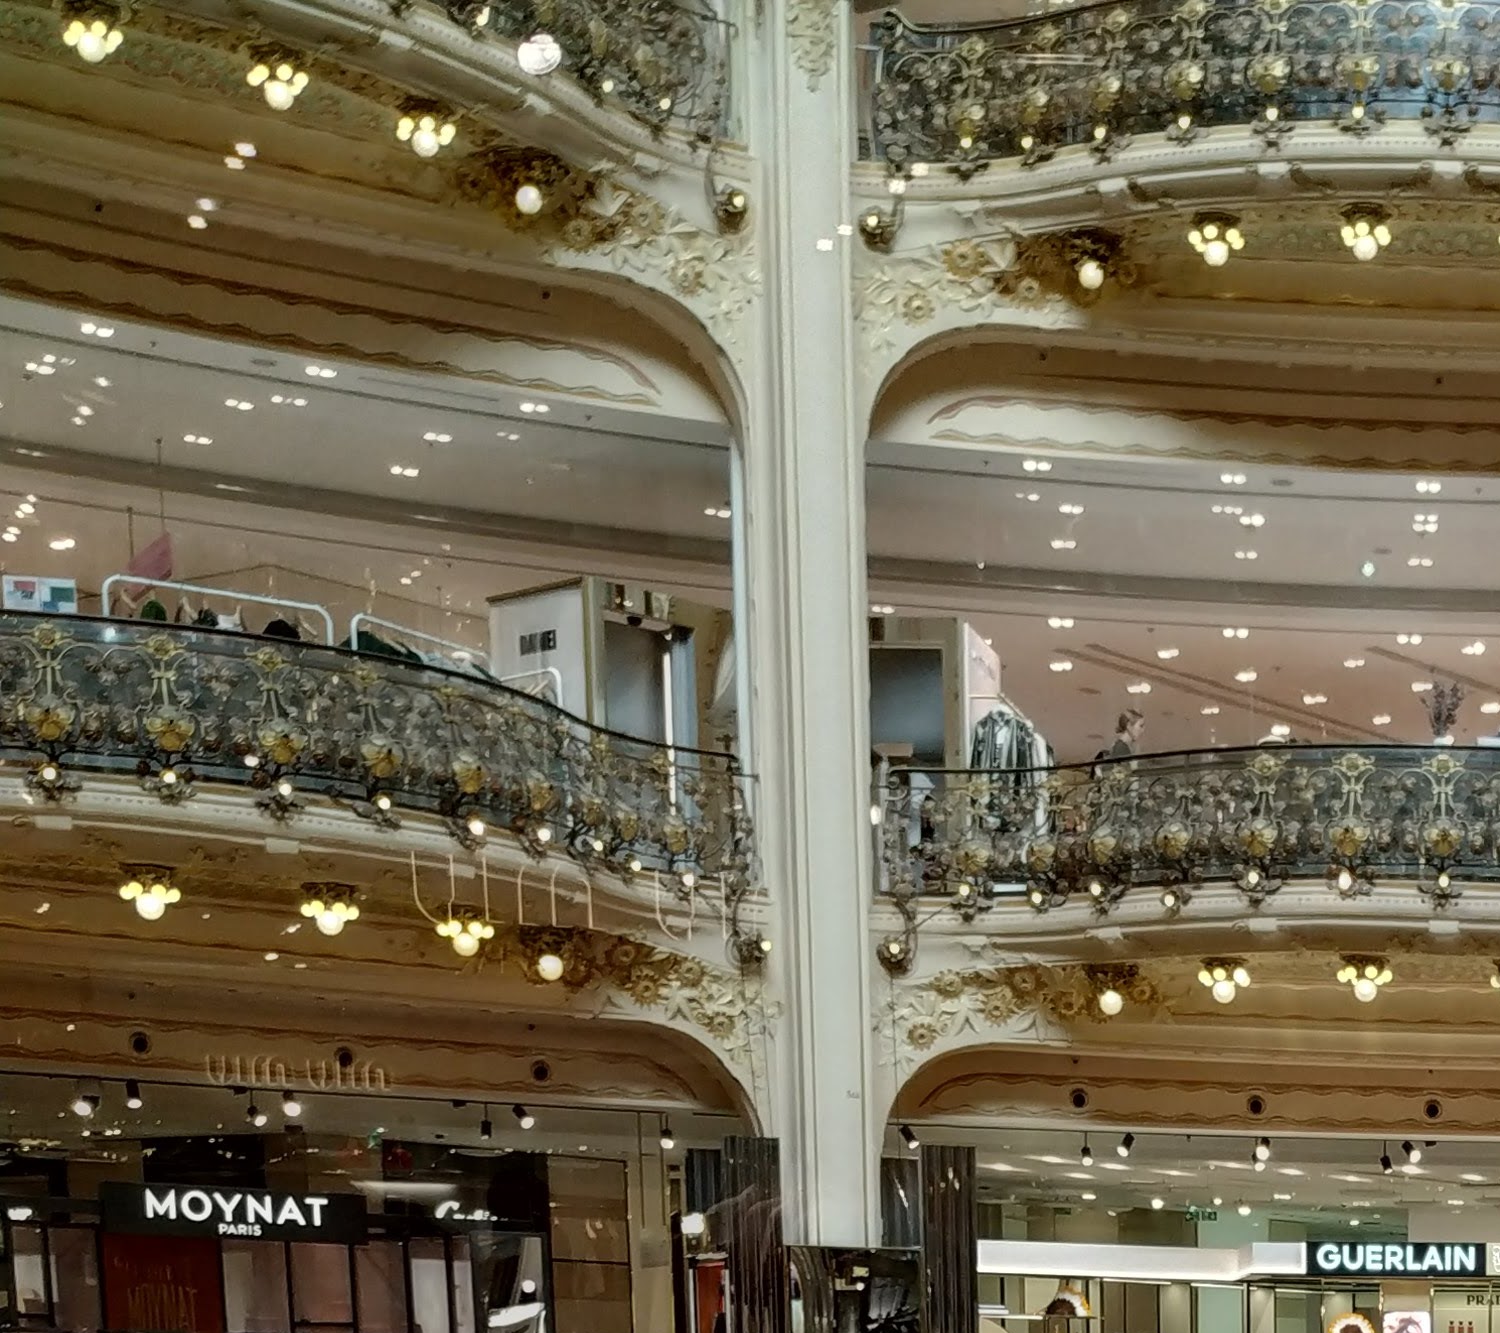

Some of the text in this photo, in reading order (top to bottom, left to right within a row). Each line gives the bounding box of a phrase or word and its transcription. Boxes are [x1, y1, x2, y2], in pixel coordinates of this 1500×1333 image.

[144, 1188, 328, 1227] MOYNAT
[218, 1223, 262, 1237] PARIS
[1316, 1245, 1475, 1272] GUERLAIN
